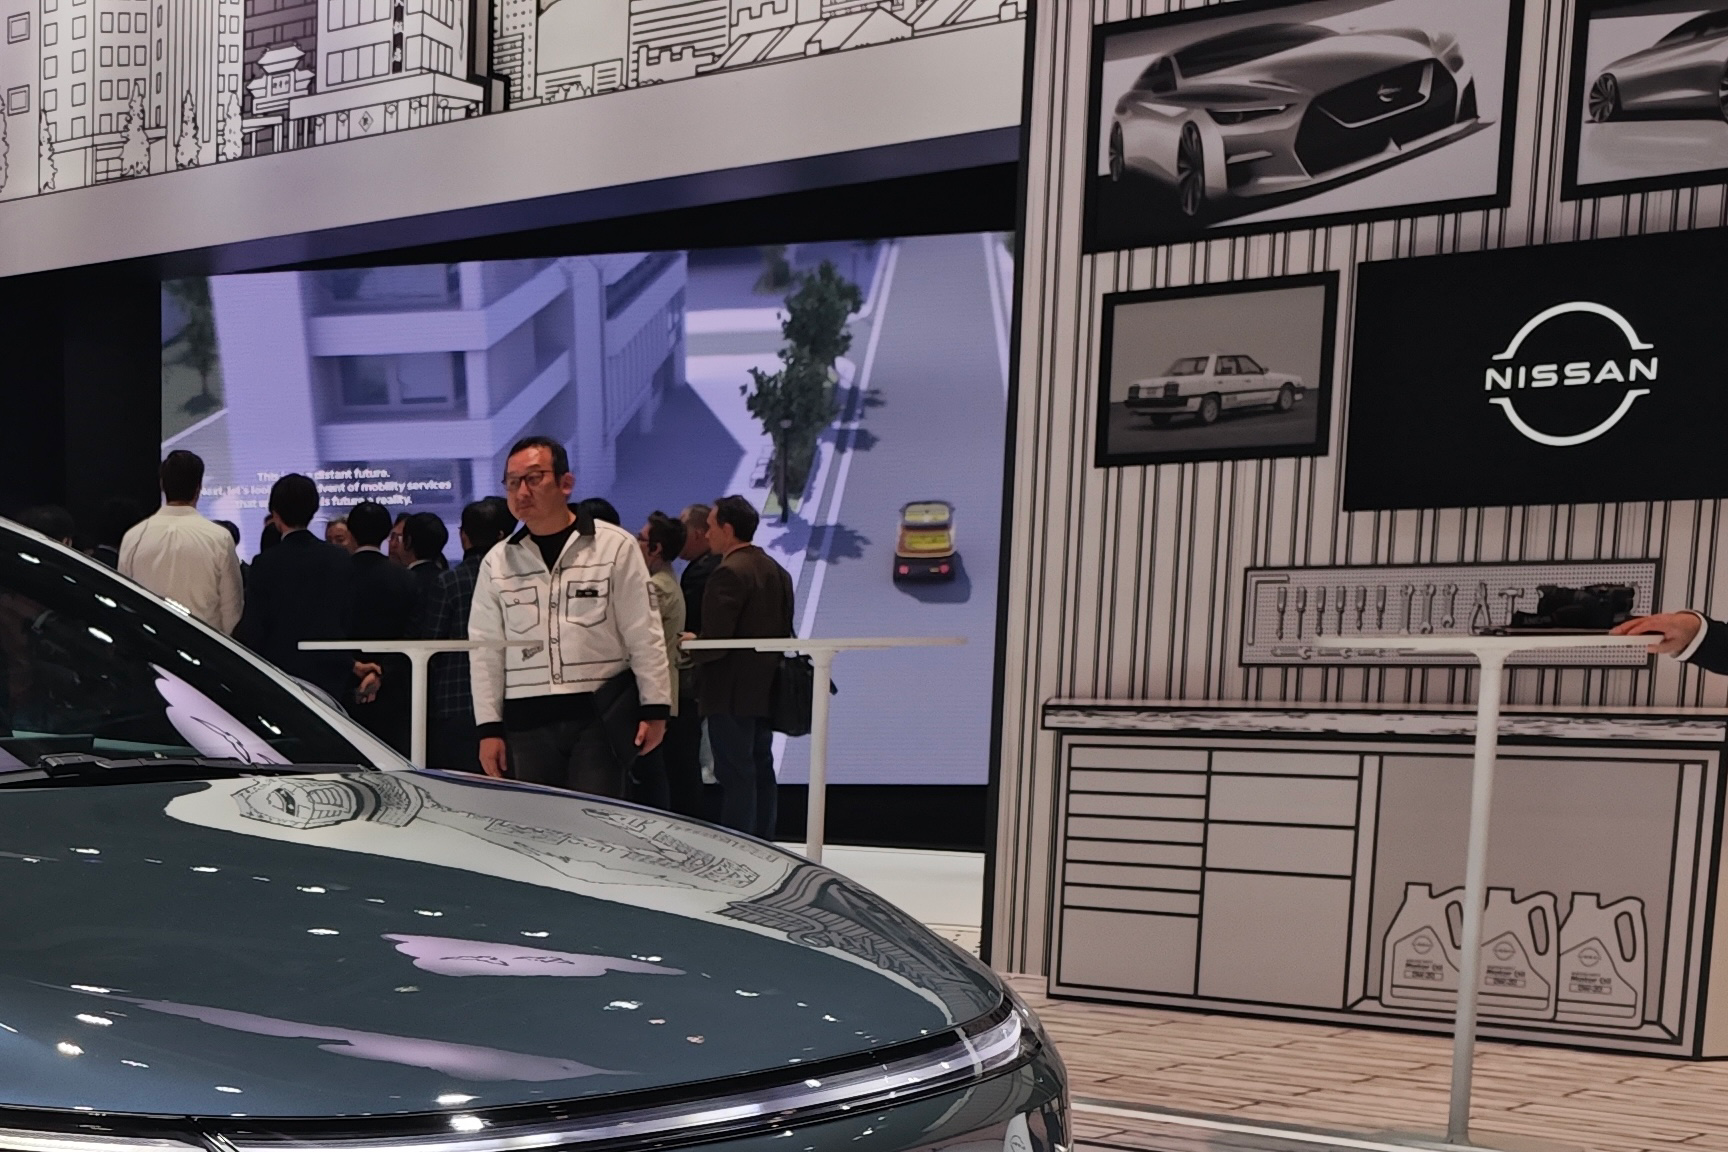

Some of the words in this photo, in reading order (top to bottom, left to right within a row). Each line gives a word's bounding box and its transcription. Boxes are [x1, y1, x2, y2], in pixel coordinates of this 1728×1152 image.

[1484, 356, 1659, 391] NISSAN
[353, 468, 391, 479] future.
[347, 481, 361, 492] of
[361, 481, 407, 493] mobility
[407, 479, 452, 491] services
